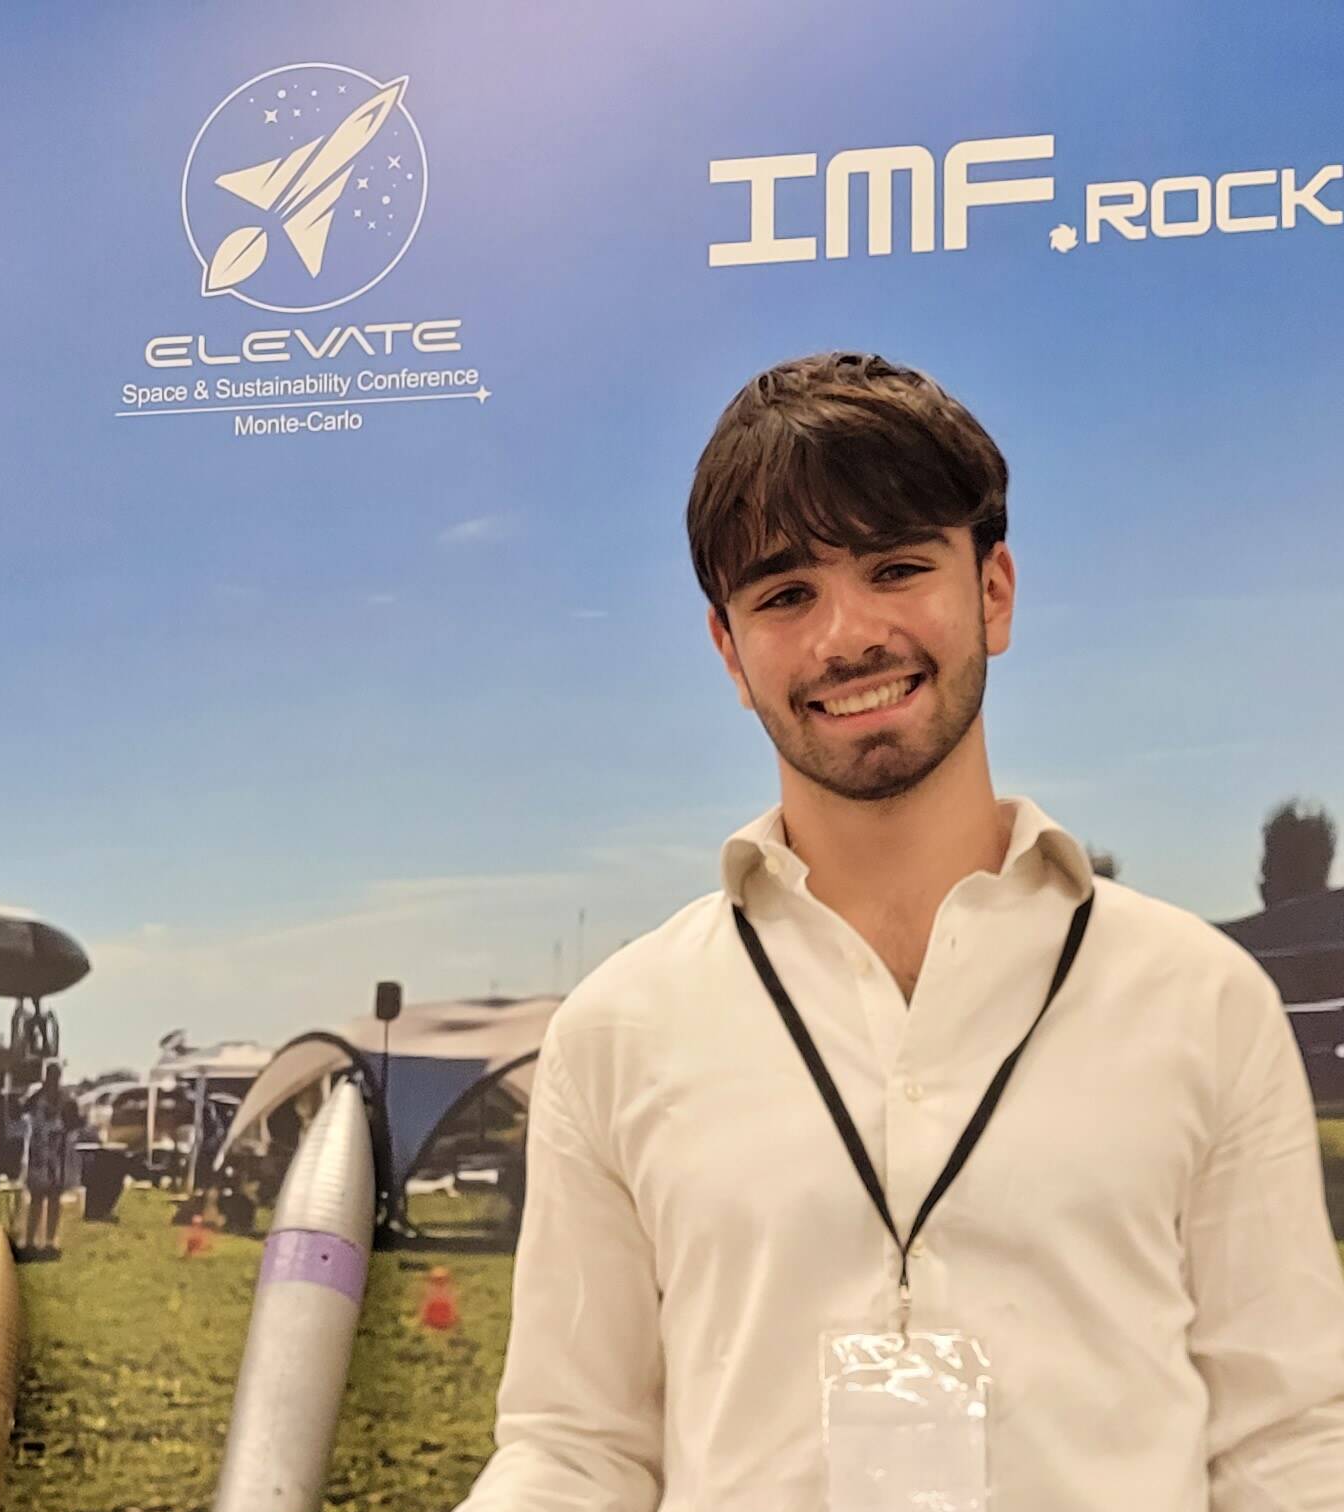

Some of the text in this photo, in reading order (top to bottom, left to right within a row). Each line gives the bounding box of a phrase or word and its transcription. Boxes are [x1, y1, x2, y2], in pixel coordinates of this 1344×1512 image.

[145, 319, 462, 368] ELEVATE
[122, 368, 479, 408] Space & Sustainability Conference
[235, 410, 363, 436] Monte-Carlo
